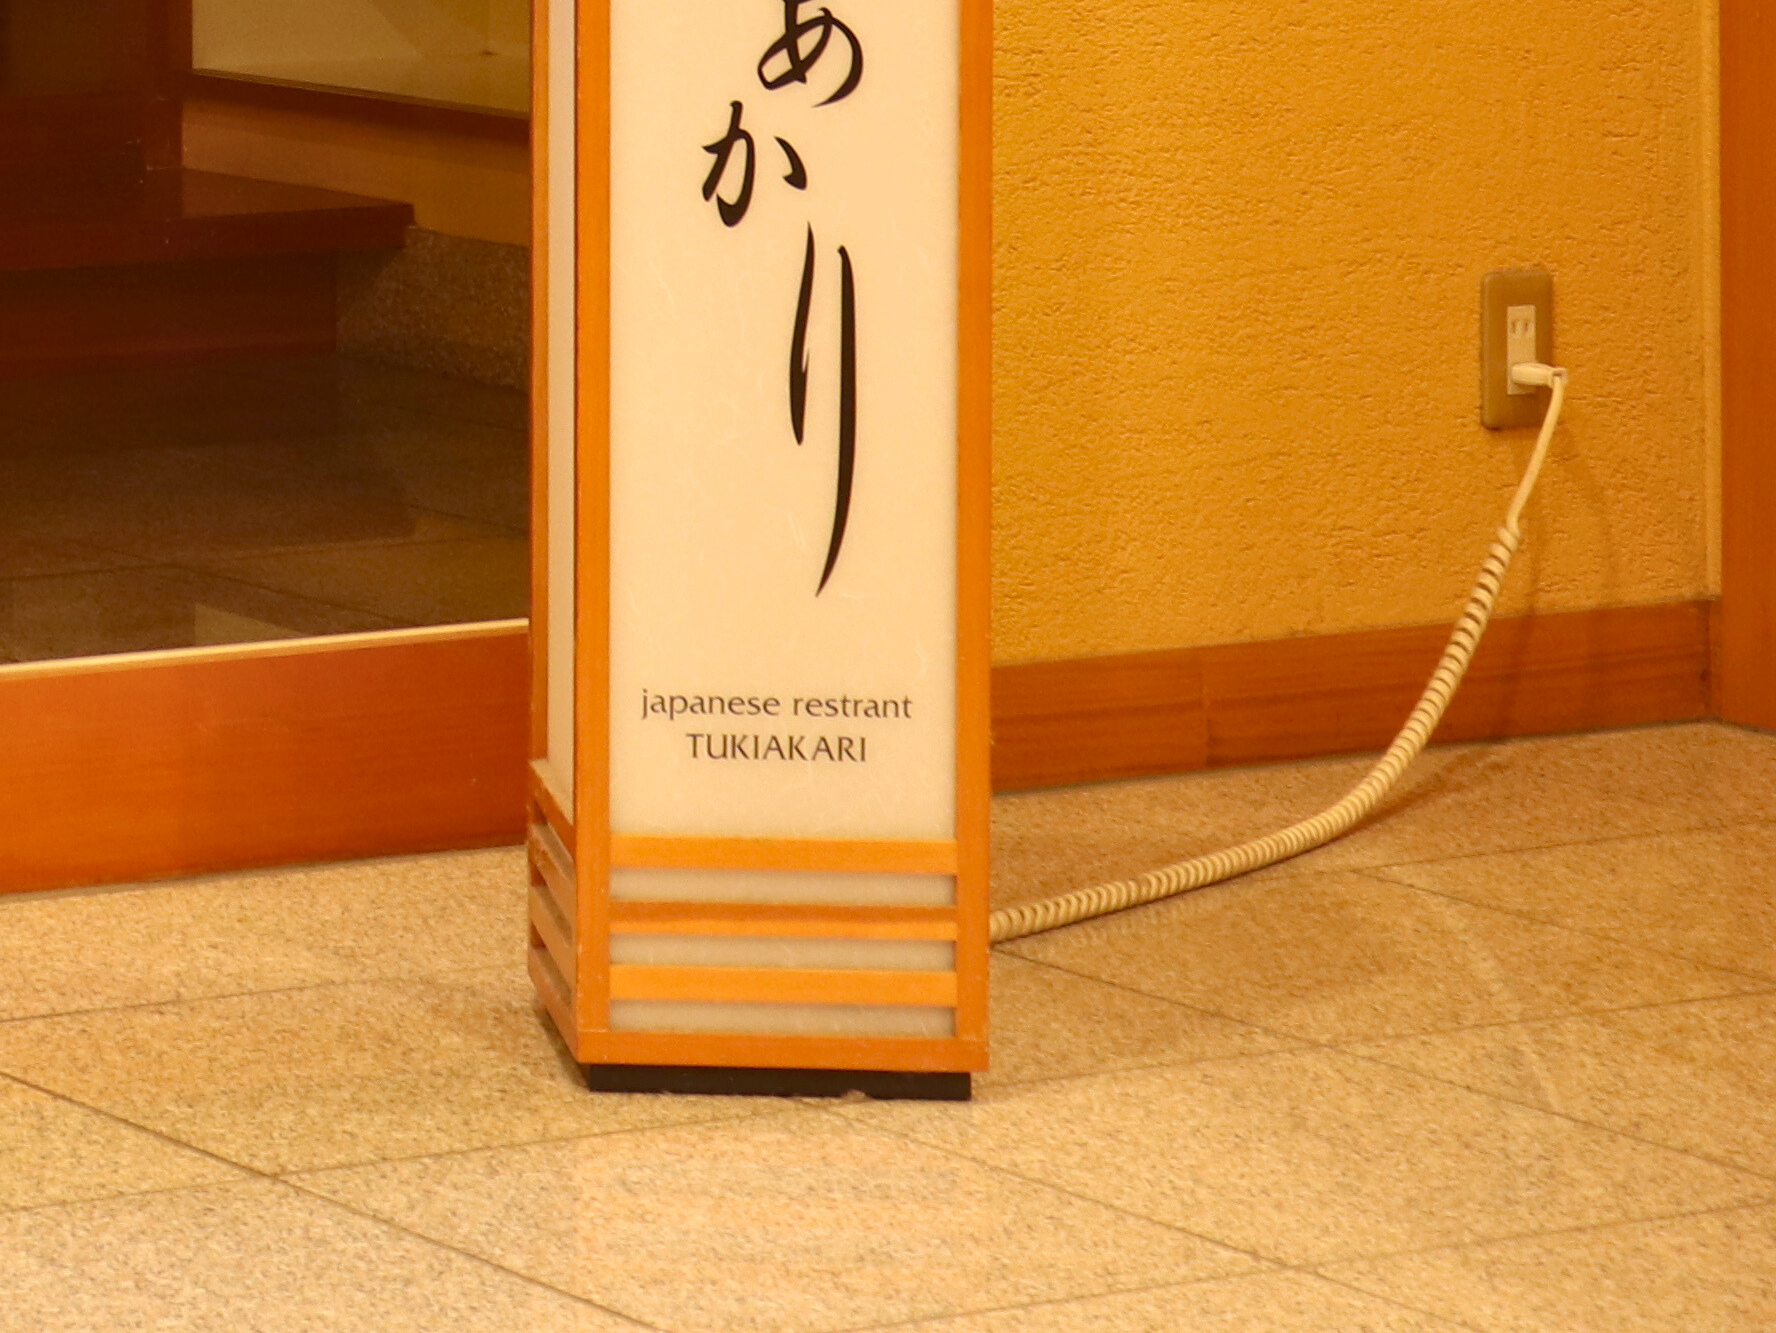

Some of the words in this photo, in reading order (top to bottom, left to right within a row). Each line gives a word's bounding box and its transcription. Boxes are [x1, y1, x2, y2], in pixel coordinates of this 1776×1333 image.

[640, 687, 782, 722] japanese
[792, 693, 914, 719] restrant
[685, 732, 867, 762] TUKIAKARI
